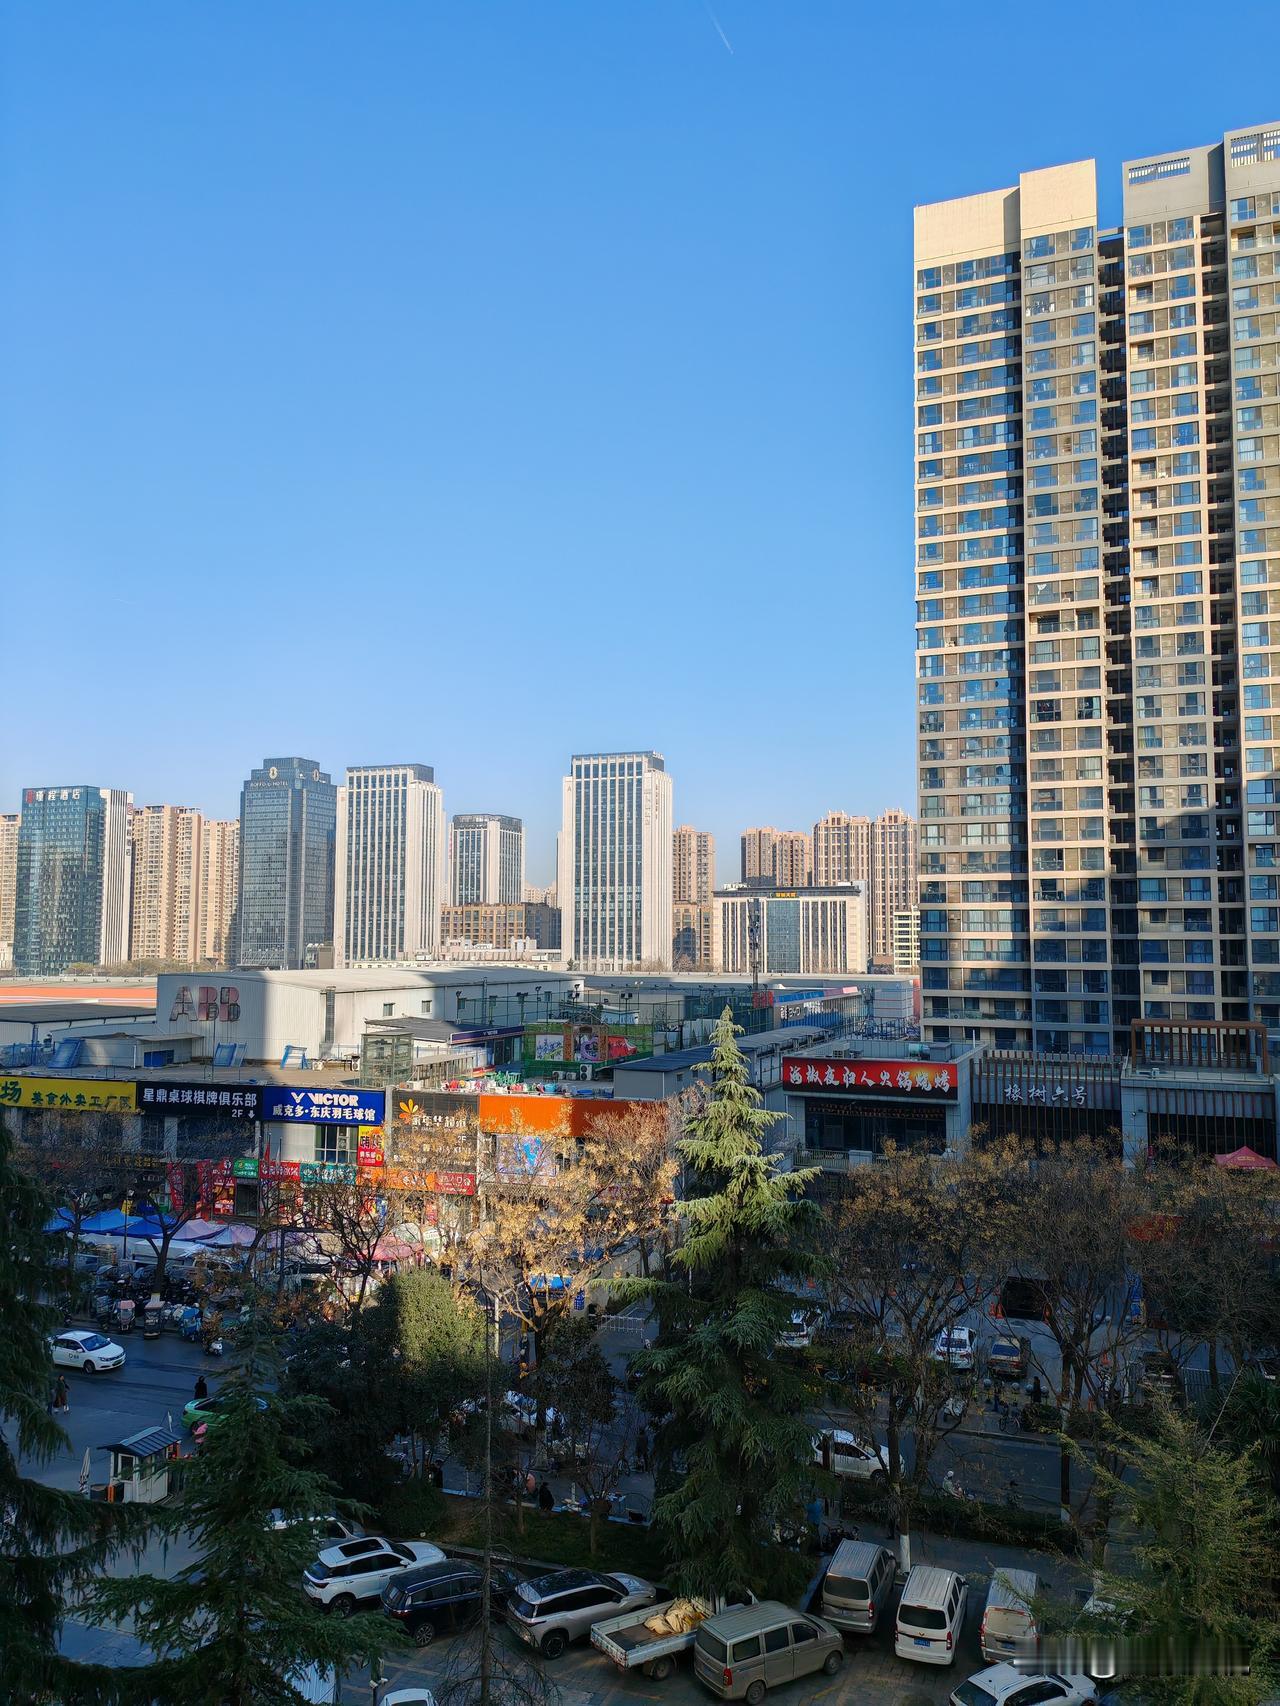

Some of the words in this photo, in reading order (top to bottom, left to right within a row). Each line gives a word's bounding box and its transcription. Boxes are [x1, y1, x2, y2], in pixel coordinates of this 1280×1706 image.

[169, 986, 241, 1022] ABB
[0, 1081, 22, 1104] 场
[143, 1088, 257, 1108] 星鼎桌球棋牌俱乐部
[307, 1093, 359, 1107] VICTOR
[231, 1109, 244, 1118] 2F
